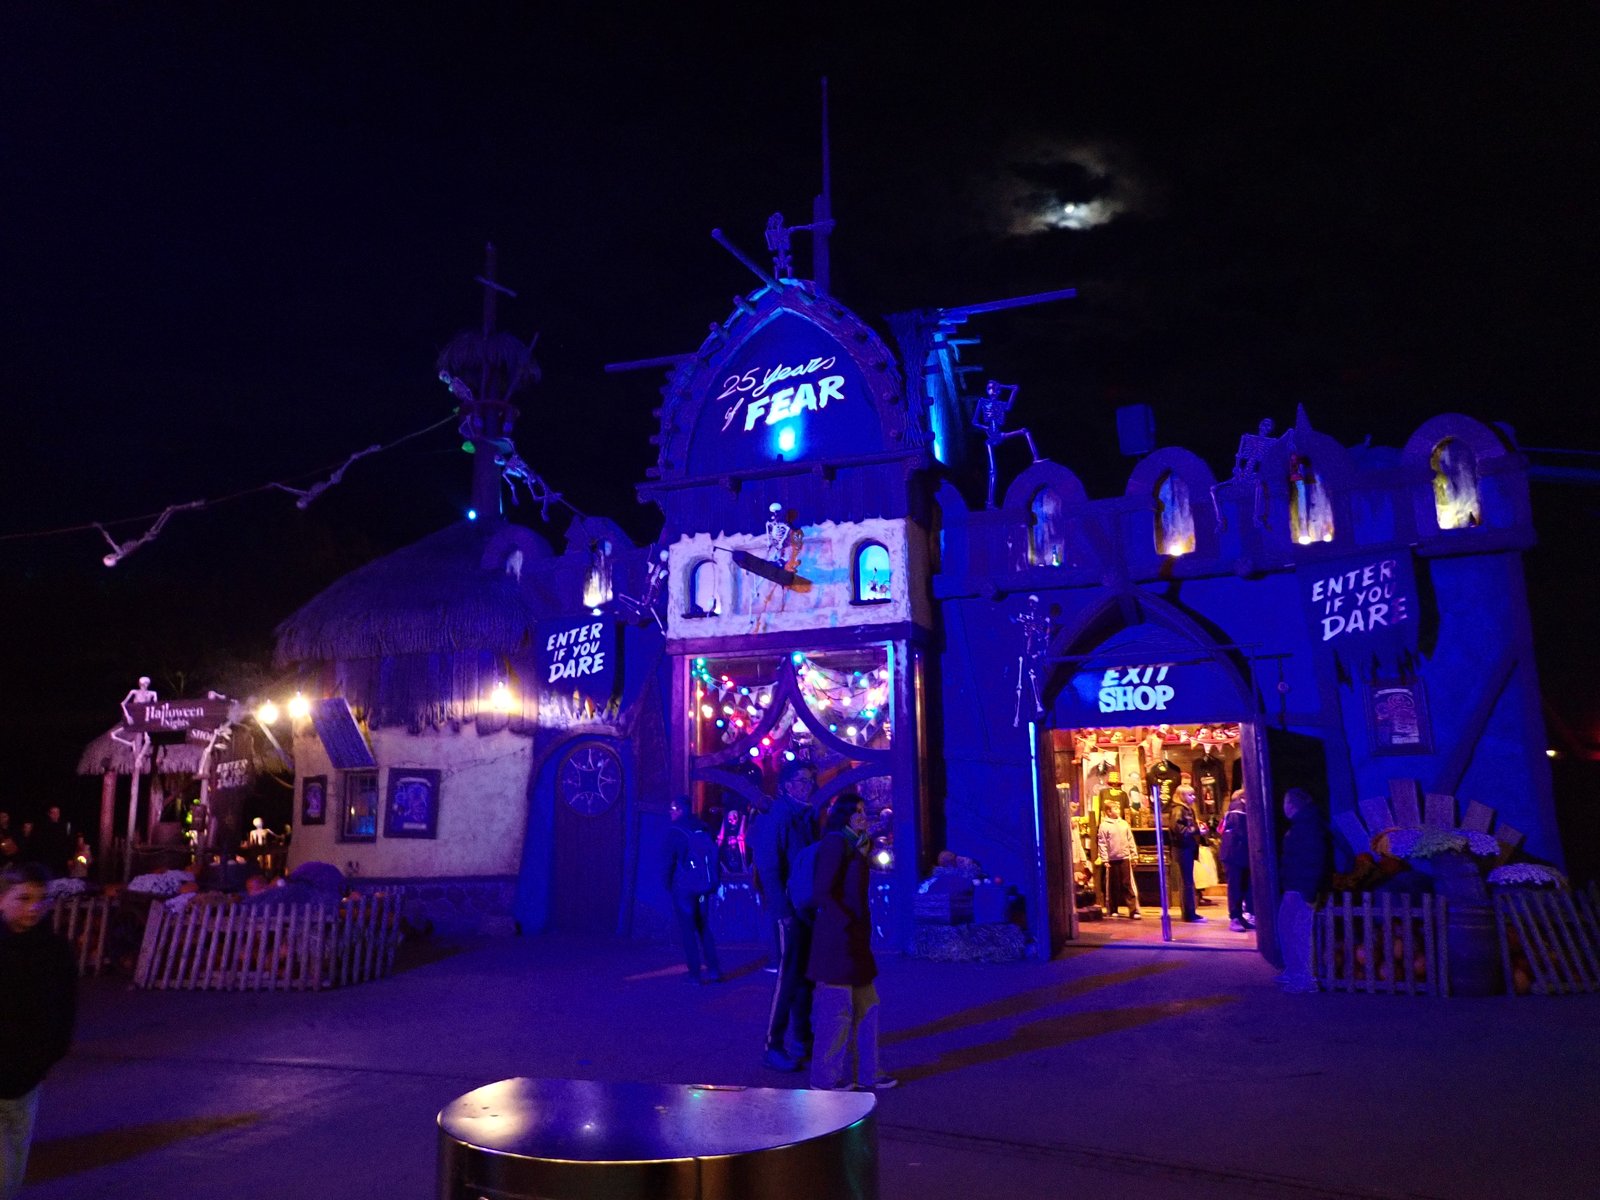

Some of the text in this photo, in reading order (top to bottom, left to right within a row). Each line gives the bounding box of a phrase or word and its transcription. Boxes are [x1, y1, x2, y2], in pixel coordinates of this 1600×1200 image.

[716, 366, 761, 400] 25
[721, 375, 845, 431] of FEAR
[1311, 559, 1397, 603] ENTER
[1325, 582, 1396, 616] IF YOU
[1320, 596, 1408, 642] DARE
[546, 622, 604, 651] ENTER
[553, 640, 600, 662] IF YOU
[547, 652, 606, 684] DARE
[1101, 664, 1172, 687] EXIT
[144, 702, 204, 726] Halloween
[1098, 684, 1175, 713] SHOP
